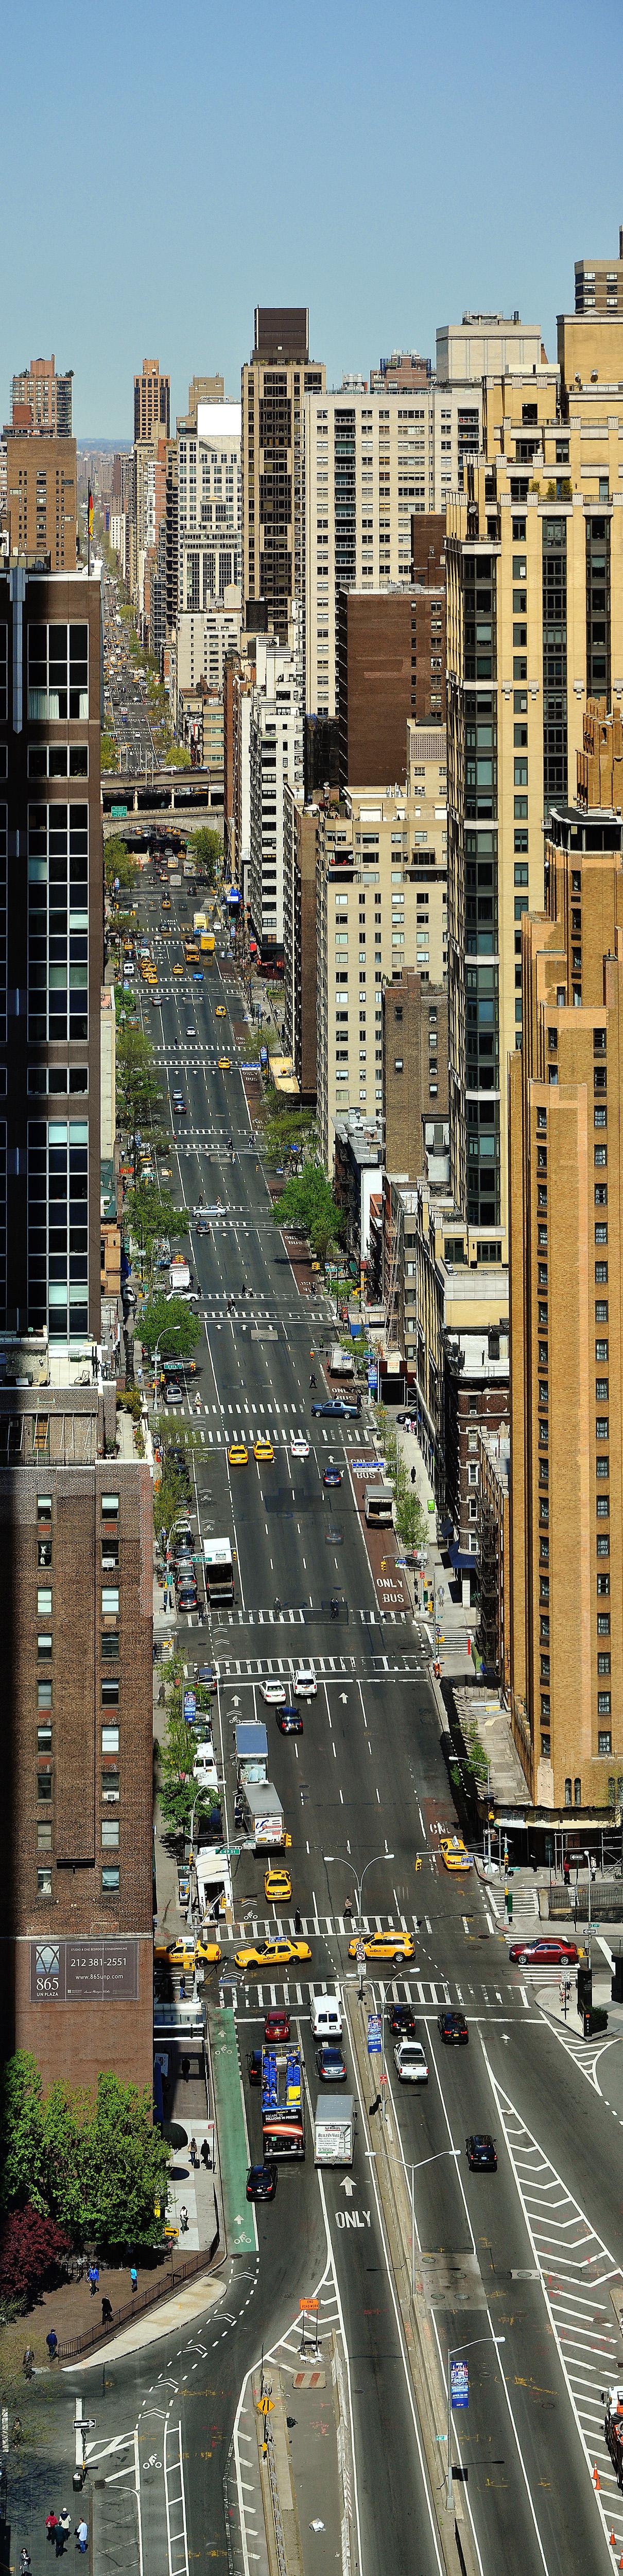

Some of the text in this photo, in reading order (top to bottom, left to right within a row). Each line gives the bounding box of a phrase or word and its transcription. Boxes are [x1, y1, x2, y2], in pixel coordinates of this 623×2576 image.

[377, 1579, 403, 1588] ONLY
[383, 1594, 404, 1603] BUS
[88, 1958, 126, 1966] 381-2551
[36, 1977, 59, 1991] 865
[335, 2211, 371, 2228] ONLY
